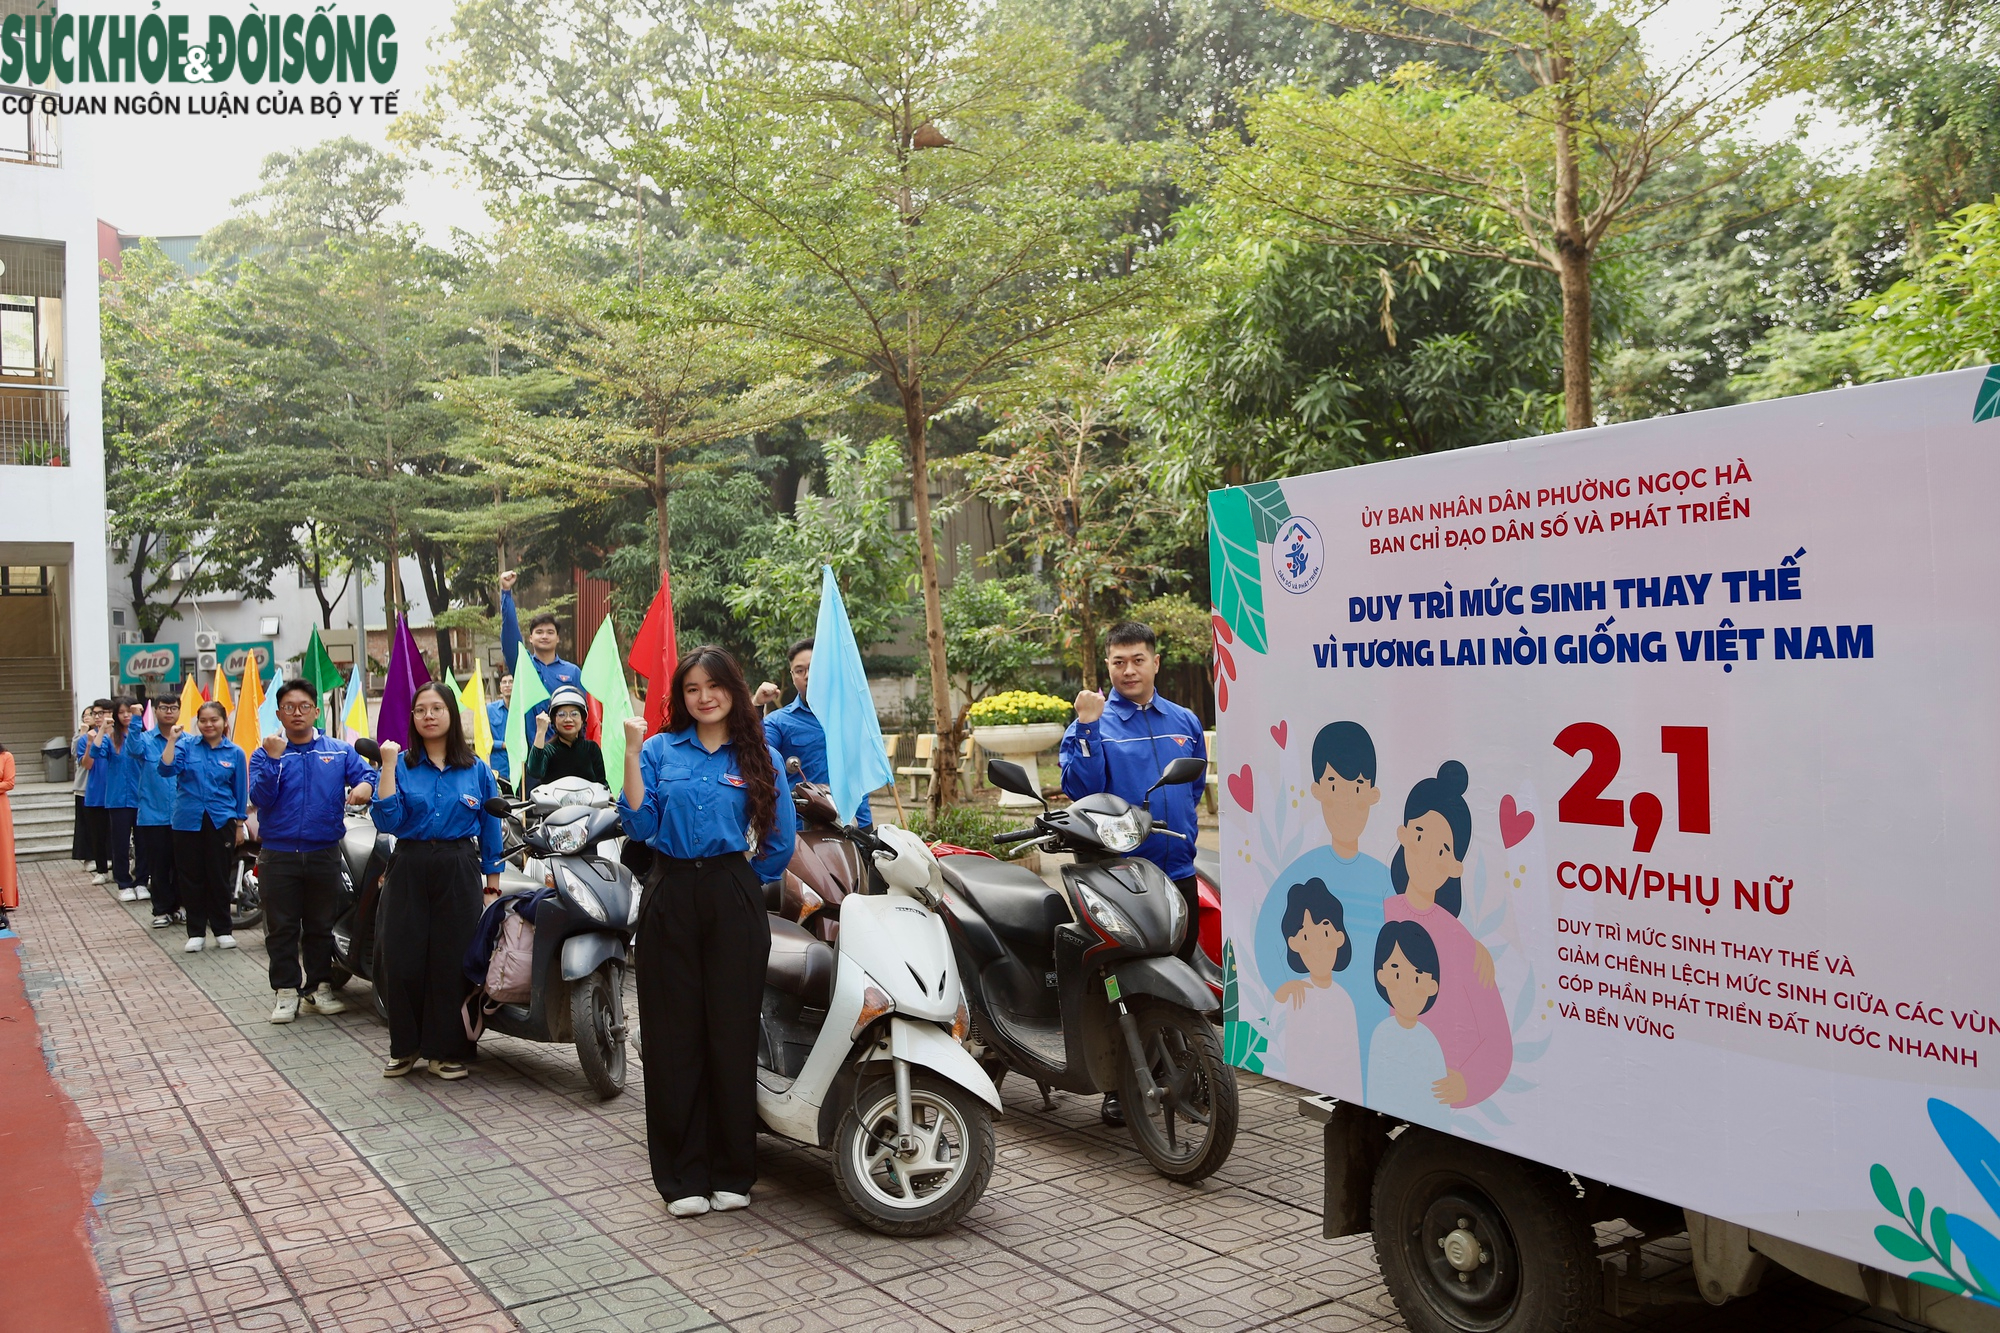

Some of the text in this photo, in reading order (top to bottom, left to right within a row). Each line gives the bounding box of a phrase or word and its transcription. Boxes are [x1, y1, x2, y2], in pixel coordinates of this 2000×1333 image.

[1362, 458, 1752, 527] ỦY BAN NHÂN DÂN PHƯỜNG NGỌC HÀ
[1370, 492, 1749, 554] BAN CHỈ ĐẠO DÂN SỐ VÀ PHÁT TRIỂN
[1350, 548, 1806, 622] DUY TRÌ MỨC SINH THAY THẾ
[133, 656, 170, 670] MILO
[1314, 617, 1873, 672] VÌ TƯƠNG LAI NÒI GIỐNG VIỆT NAM
[1553, 722, 1710, 853] 2,1
[1557, 861, 1793, 915] CON/PHỤ NỮ
[1558, 918, 1854, 976] DUY TRÌ MỨC SINH THAY THẾ VÀ
[1558, 944, 1599, 966] GIẢM
[1605, 955, 1665, 976] CHÊNH
[1673, 964, 1719, 986] LỆCH
[1727, 974, 1771, 995] MỨC
[1778, 982, 1826, 1005] SINH
[1834, 992, 1888, 1016] GIỮA
[1896, 1001, 1943, 1025] CÁC
[1558, 974, 1977, 1067] GÓP PHẦN PHÁT TRIỂN ĐẤT NƯỚC NHANH
[1558, 1002, 1674, 1039] VÀ BỀN VỮNG
